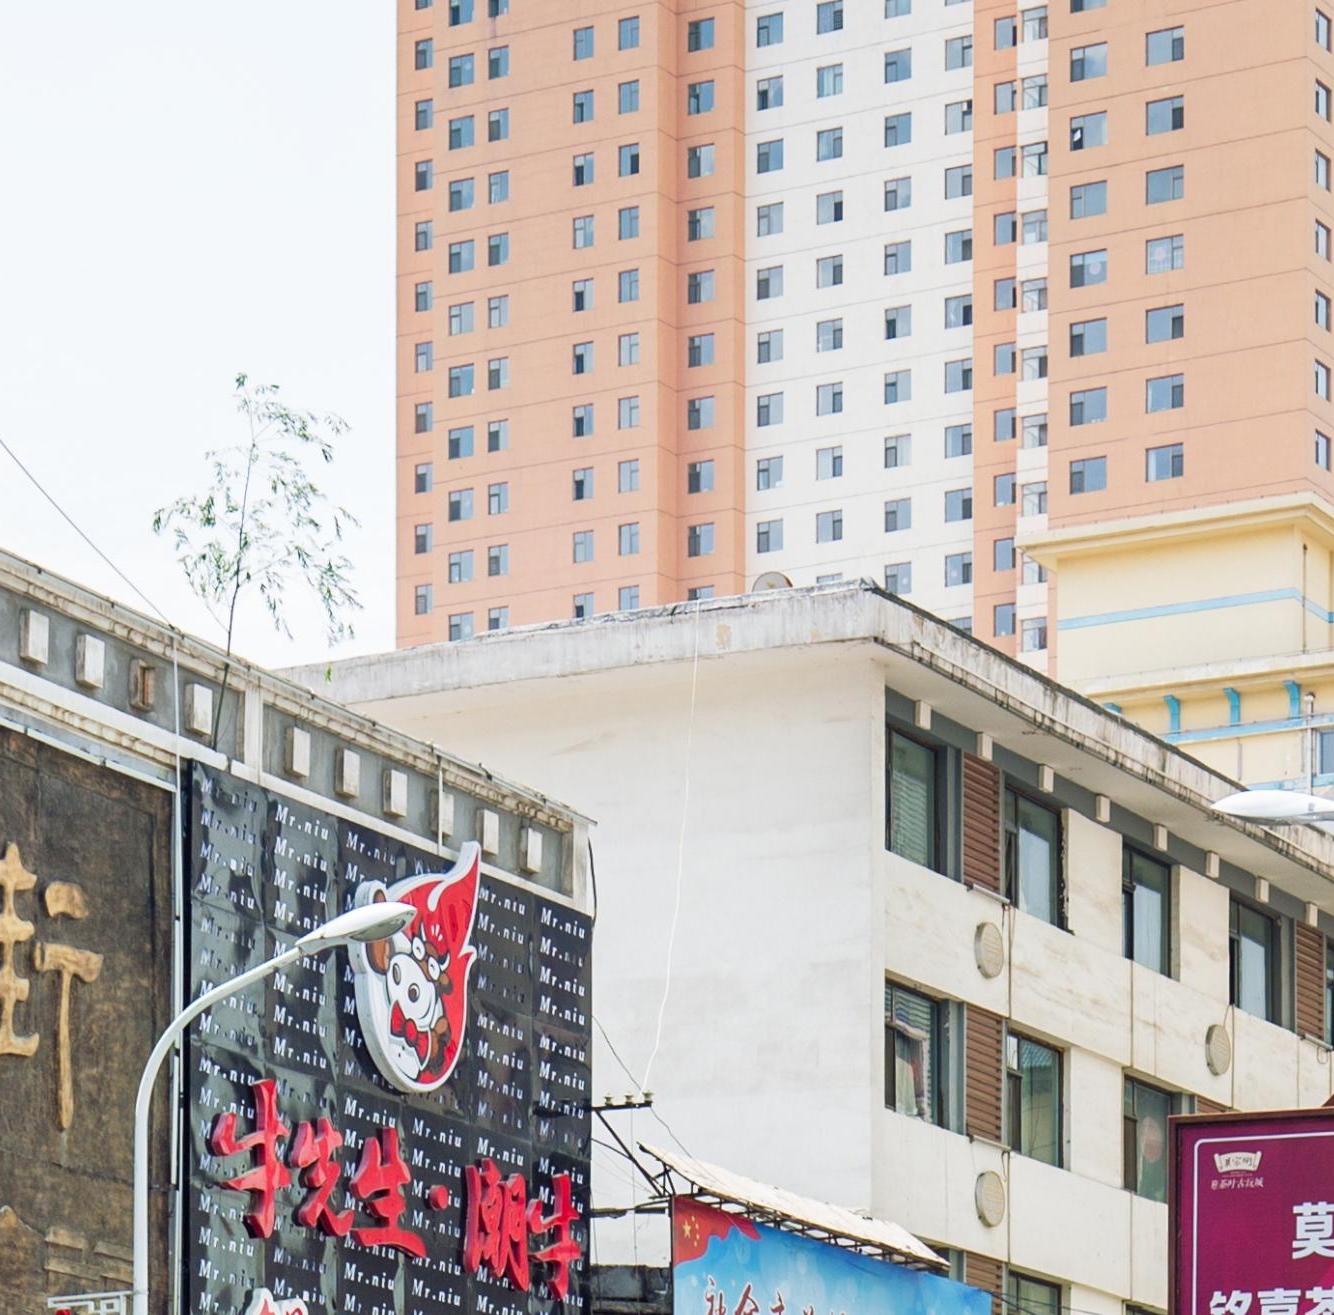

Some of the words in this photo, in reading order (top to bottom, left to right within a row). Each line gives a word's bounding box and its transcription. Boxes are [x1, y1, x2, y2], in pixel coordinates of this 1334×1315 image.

[274, 804, 328, 841] Mr.niu
[274, 837, 328, 872] Mr.niu
[345, 831, 396, 866] Mr.niu
[274, 869, 328, 903] Mr.niu
[478, 886, 524, 915] Mr.niu
[478, 913, 524, 944] Mr.niu
[540, 907, 585, 939] Mr.niu
[274, 972, 328, 1006] Mr.niu
[540, 967, 585, 997] Mr.niu
[274, 1005, 328, 1038] Mr.niu
[540, 997, 585, 1026] Mr.niu
[478, 1014, 524, 1041] Mr.niu
[274, 1037, 328, 1070] Mr.niu
[478, 1040, 524, 1070] Mr.niu
[540, 1034, 585, 1062] Mr.niu
[199, 1057, 255, 1087] Mr.niu
[478, 1071, 524, 1100] Mr.niu
[540, 1062, 585, 1091] Mr.niu
[199, 1087, 255, 1118] Mr.niu
[345, 1097, 396, 1128] Mr.niu
[412, 1118, 461, 1148] Mr.niu
[412, 1149, 461, 1178] Mr.niu
[478, 1137, 524, 1166] Mr.niu
[412, 1210, 461, 1238] Mr.niu
[199, 1226, 255, 1256] Mr.niu
[345, 1262, 396, 1290] Mr.niu
[412, 1279, 461, 1306] Mr.niu
